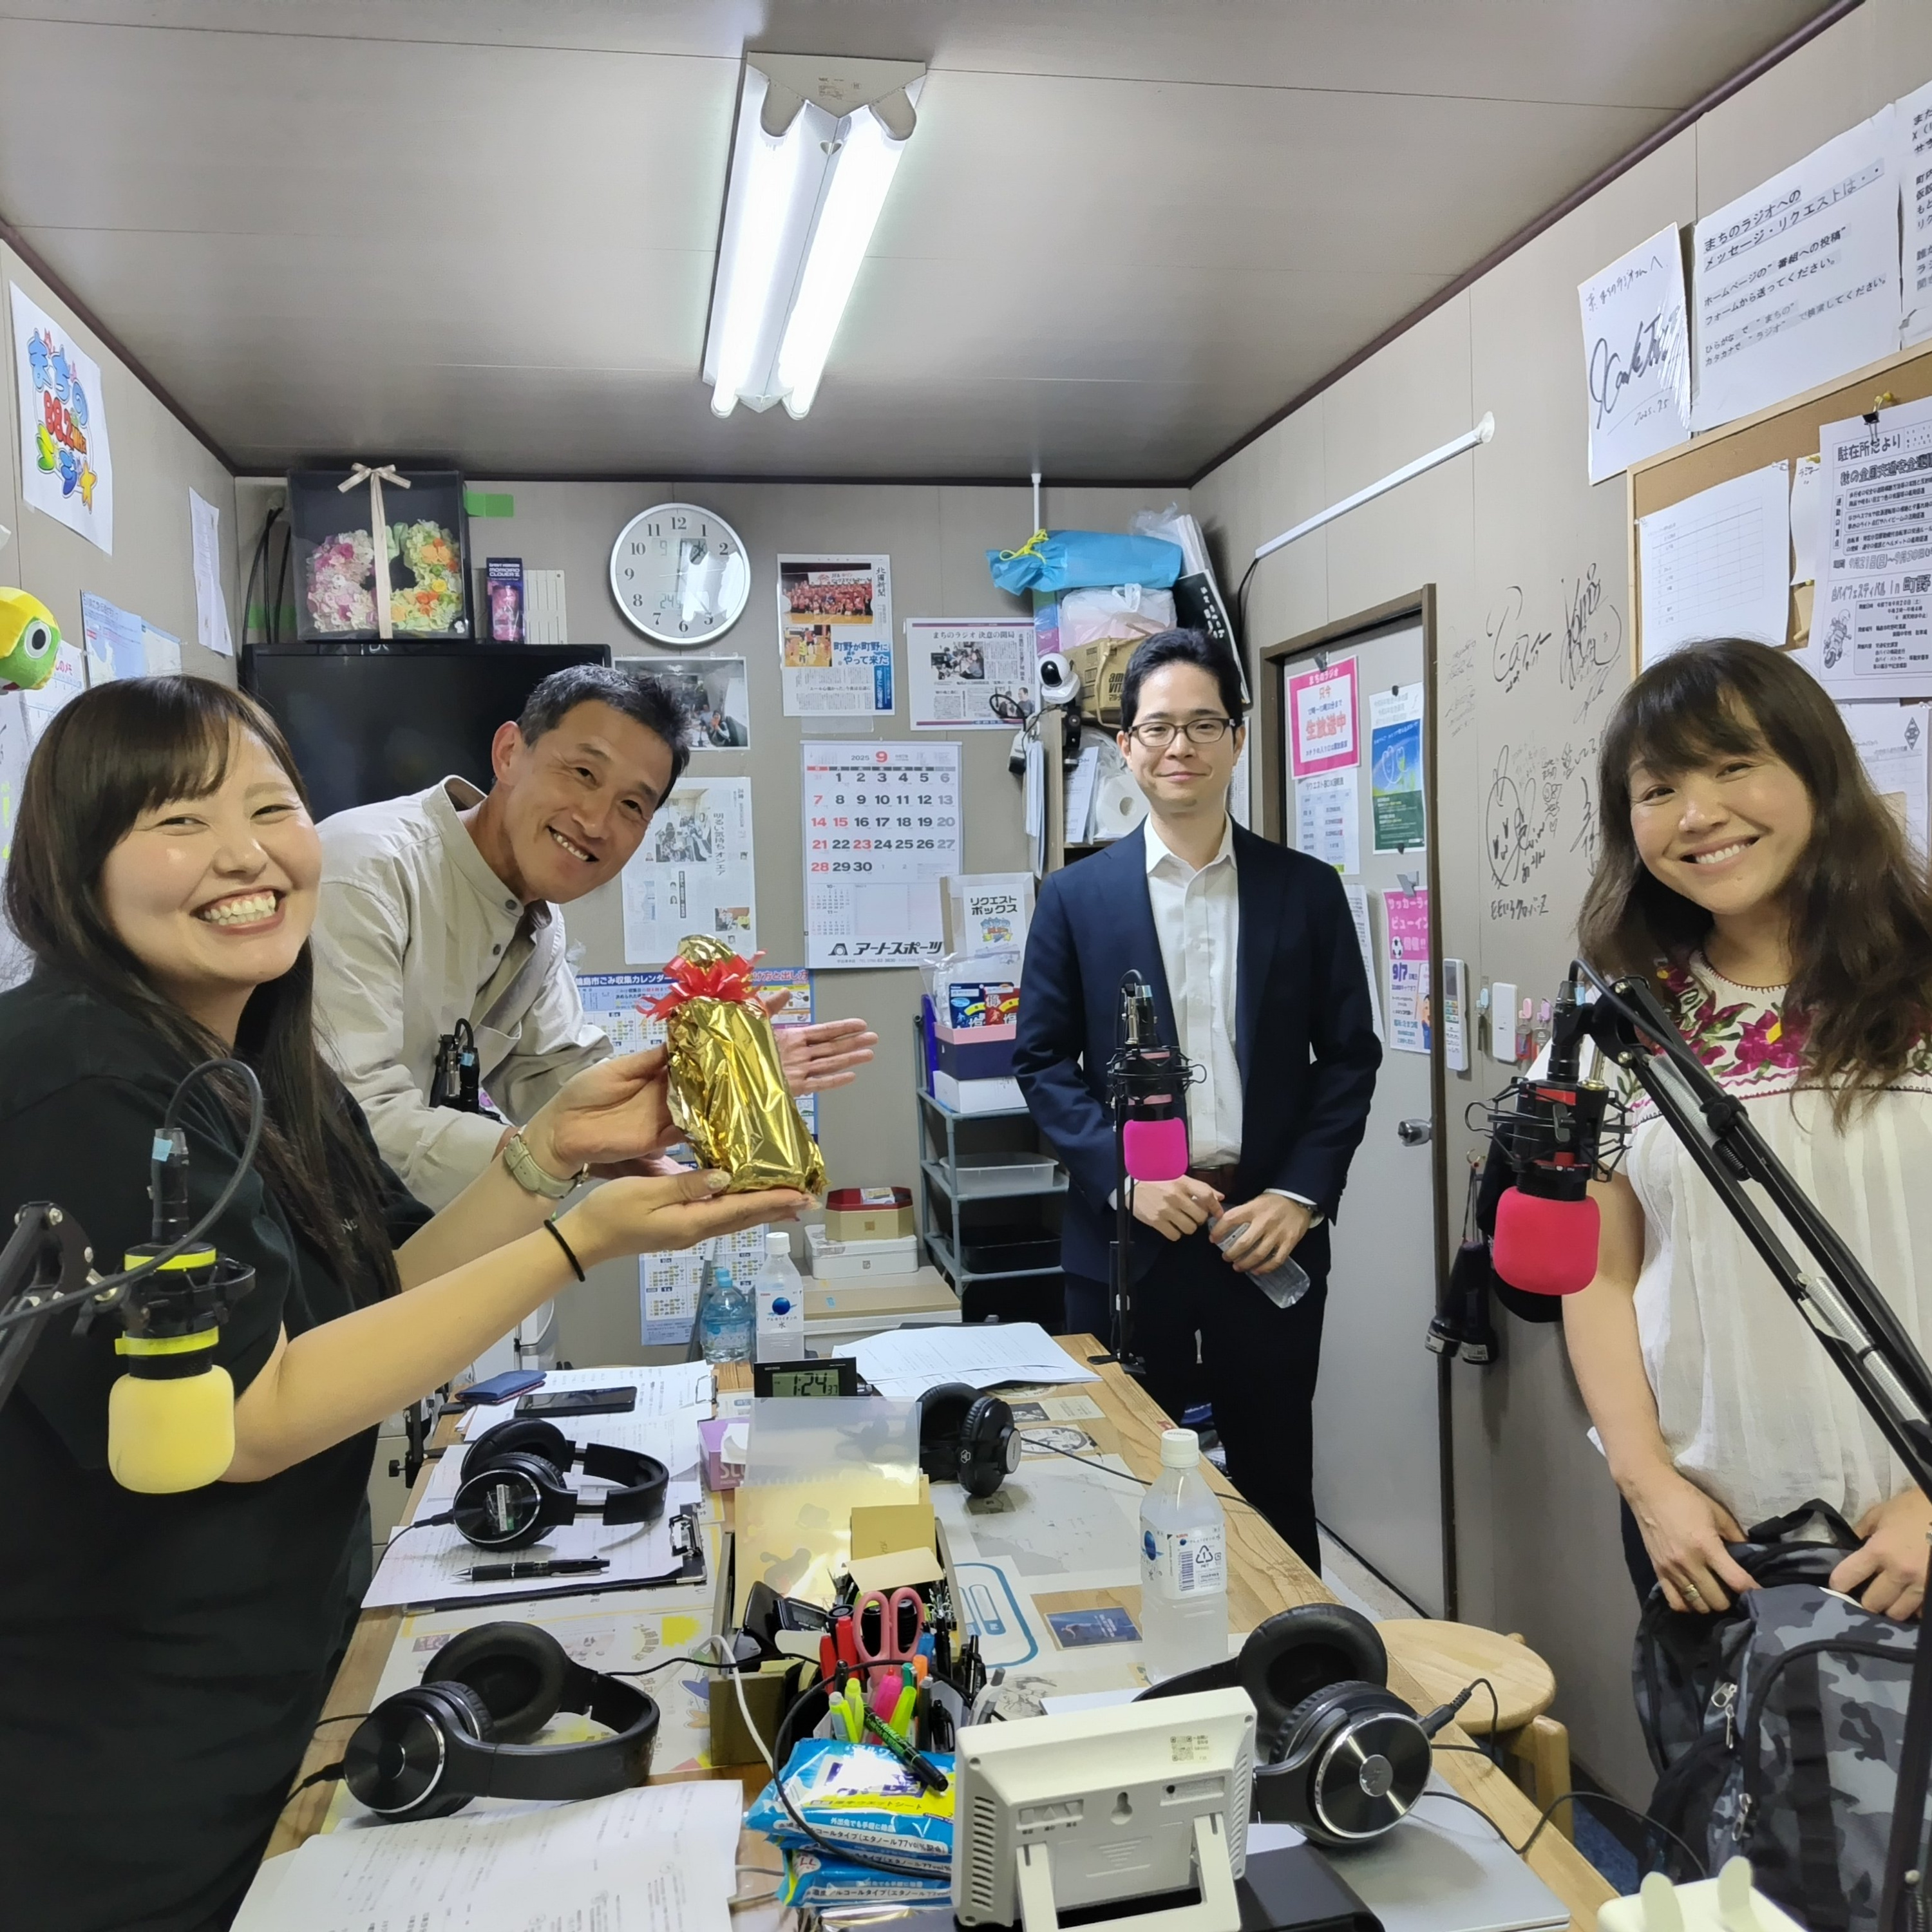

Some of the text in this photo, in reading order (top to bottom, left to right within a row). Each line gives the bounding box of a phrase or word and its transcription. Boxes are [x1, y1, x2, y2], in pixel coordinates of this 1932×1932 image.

[1704, 189, 1802, 252] まちのラジオへの
[1705, 258, 1837, 326] フォームから送ってください。
[670, 517, 687, 530] 12
[647, 524, 661, 536] 11
[701, 524, 708, 536] 1
[630, 542, 646, 555] 10
[719, 542, 729, 555] 2
[625, 568, 634, 580] 9
[1903, 574, 1931, 593] 町野
[632, 594, 643, 607] 8
[652, 612, 661, 625] 7
[679, 620, 688, 632] 6
[833, 641, 889, 651] 町野が町野に
[844, 655, 889, 665] やって来た
[1306, 710, 1346, 741] 生放送中
[875, 751, 888, 762] 9
[836, 773, 841, 782] 1
[857, 773, 865, 782] 2
[878, 773, 887, 782] 3
[898, 773, 908, 782] 4
[920, 773, 929, 782] 5
[941, 773, 949, 782] 6
[814, 795, 952, 804] 7 8 9 10 11 12 13
[812, 817, 954, 827] 14 15 16 17 18 19 20
[813, 840, 954, 849] 21 22 23 24 25 26 27
[811, 862, 829, 871] 28
[833, 862, 851, 871] 29
[853, 862, 872, 871] 30
[971, 895, 1017, 906] リクエスト
[971, 904, 1018, 915] ボックス
[853, 942, 943, 956] アートスポーツ
[1392, 962, 1408, 982] 9/7
[793, 1372, 828, 1396] 1:24
